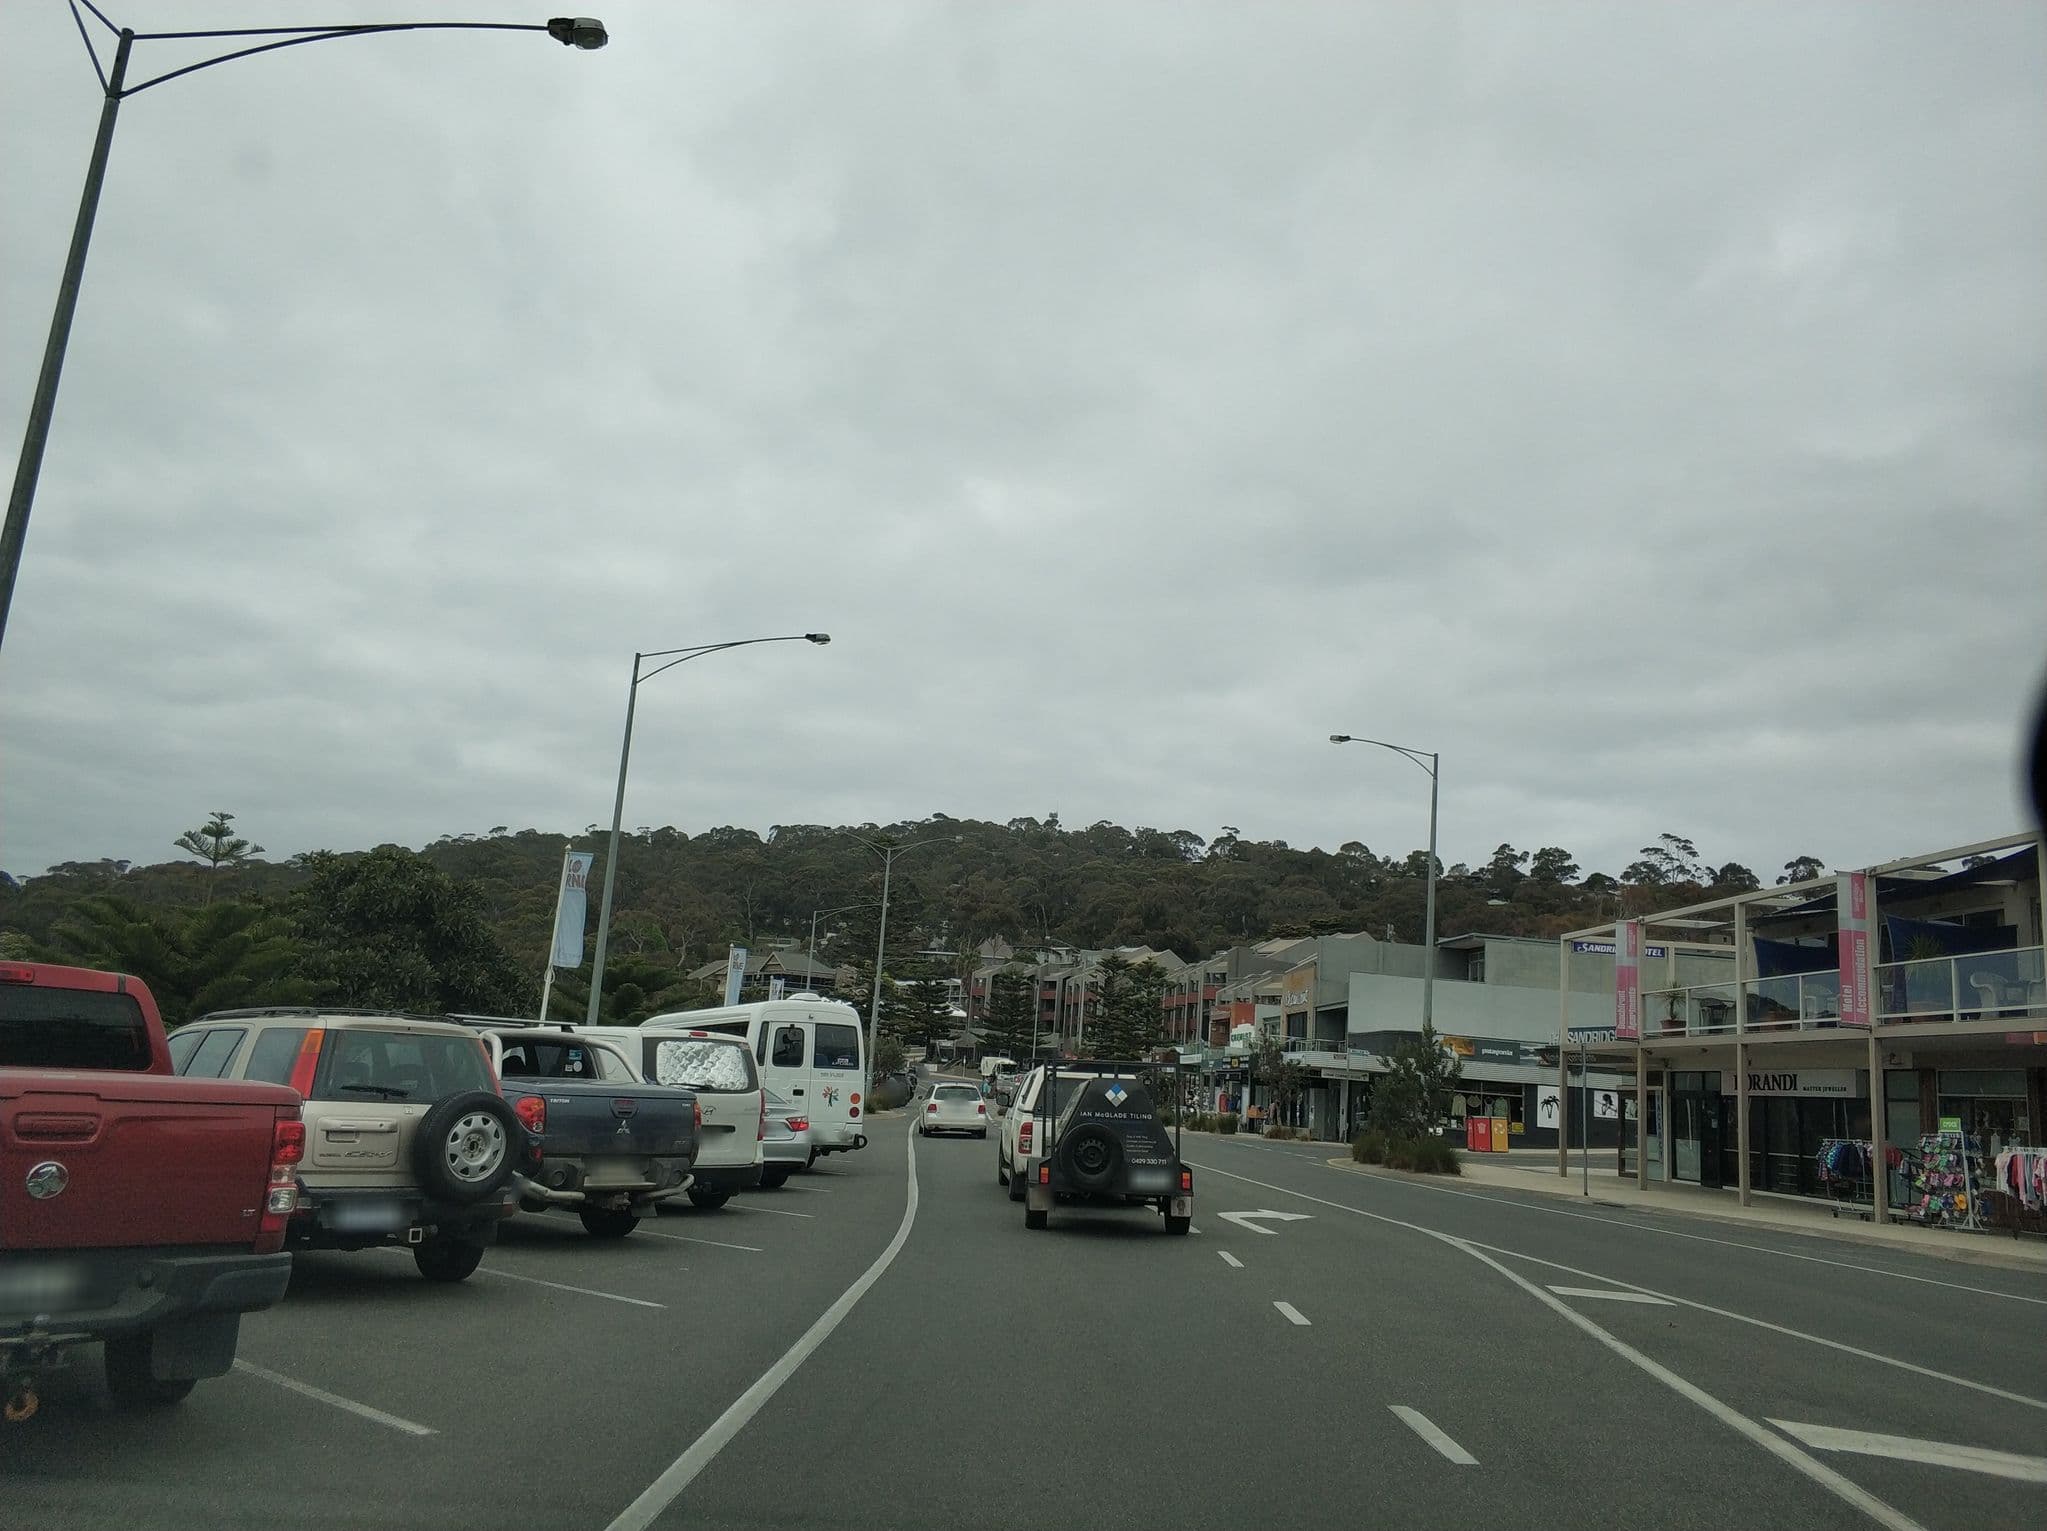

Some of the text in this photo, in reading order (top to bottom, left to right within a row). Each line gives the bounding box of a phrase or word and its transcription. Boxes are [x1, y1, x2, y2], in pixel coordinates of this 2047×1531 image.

[1582, 943, 1662, 957] SANDRI TEL
[1855, 938, 1867, 1014] Accommodation
[1842, 985, 1853, 1012] Motel
[1568, 1030, 1617, 1044] SANDRIDG
[1481, 1047, 1514, 1057] patagonia
